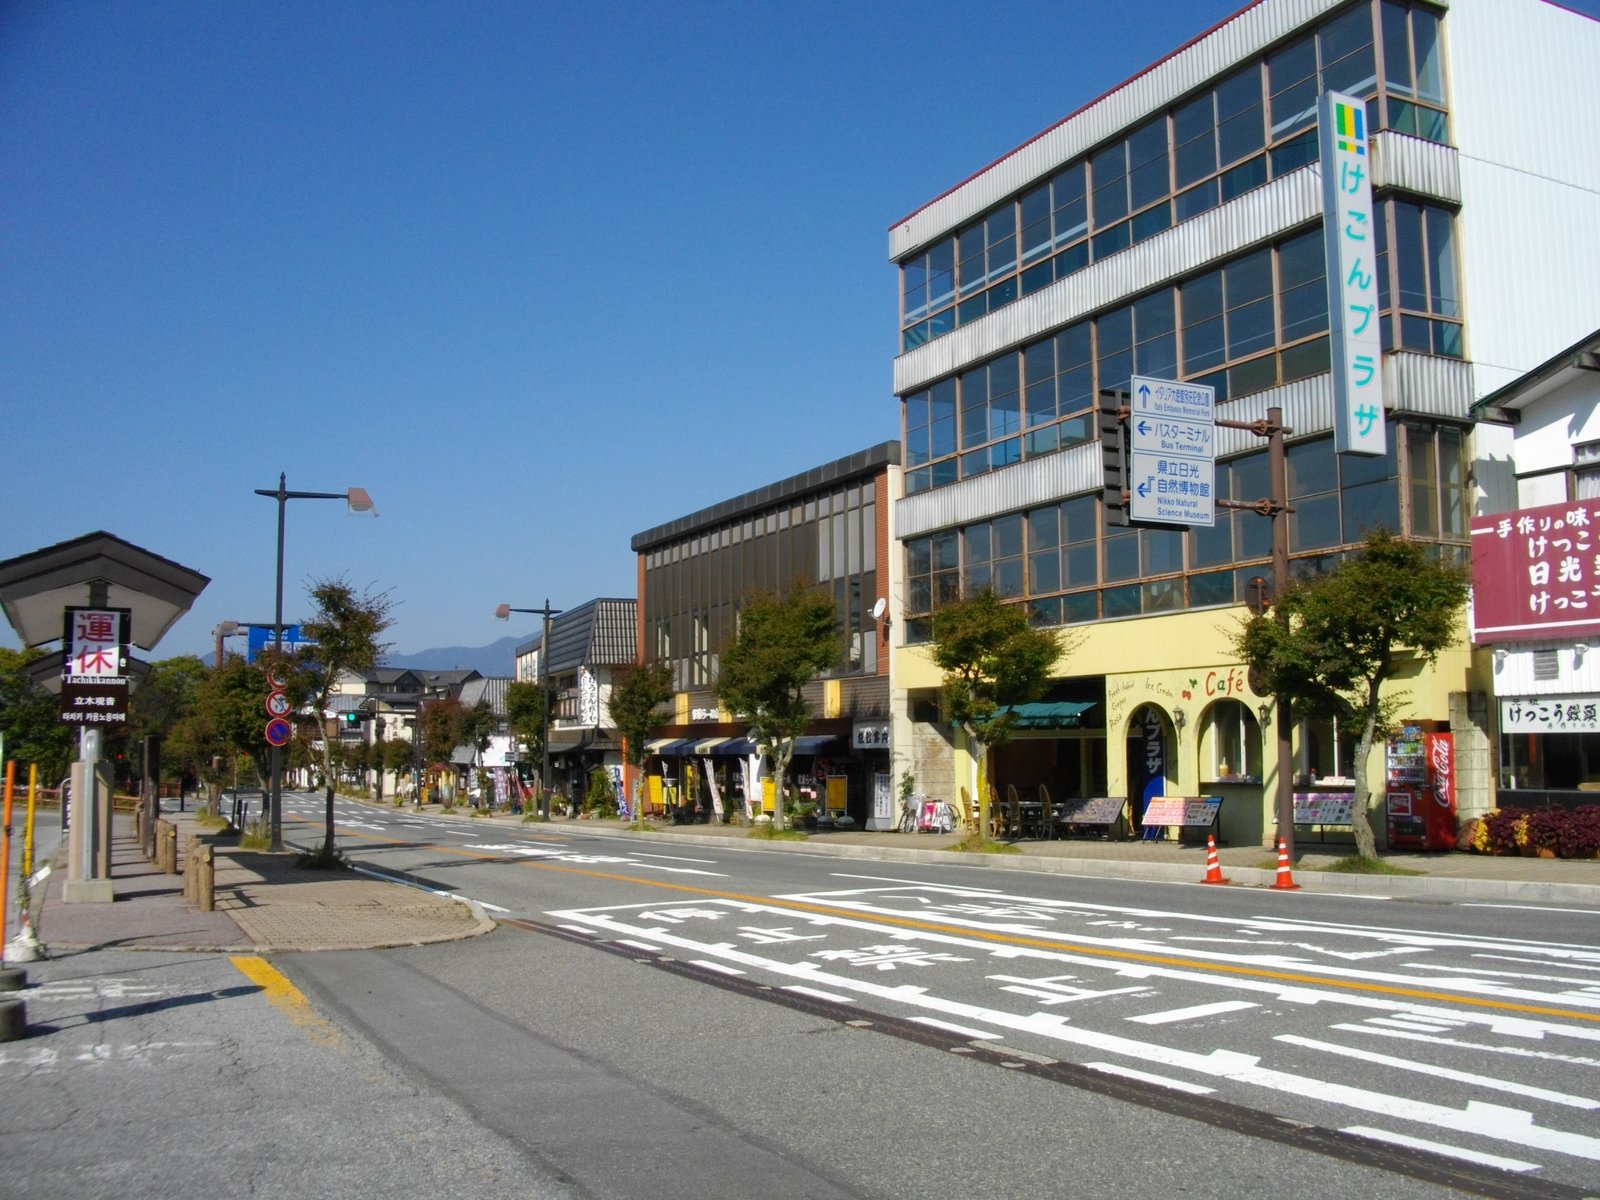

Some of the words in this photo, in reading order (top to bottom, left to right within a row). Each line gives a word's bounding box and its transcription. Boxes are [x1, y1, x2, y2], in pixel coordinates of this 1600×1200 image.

[1341, 161, 1380, 437] けごんプラザ
[1155, 423, 1210, 443] バスターミナル
[1161, 440, 1173, 449] Bus
[1176, 442, 1203, 452] Terminal
[1158, 460, 1199, 478] 県立日光
[1158, 479, 1209, 497] 自然博物館
[1158, 497, 1175, 506] Nikko
[1176, 499, 1197, 508] Natural
[1158, 507, 1182, 517] Science
[1184, 510, 1209, 519] Museum
[1497, 507, 1590, 538] 手作りの味
[76, 613, 115, 673] 運休
[67, 676, 126, 685] Tachikikannon
[1145, 677, 1154, 690] Ice
[1206, 668, 1243, 696] Café
[1509, 703, 1597, 723] けっこう饅頭
[1432, 735, 1450, 808] Coca-Cola
